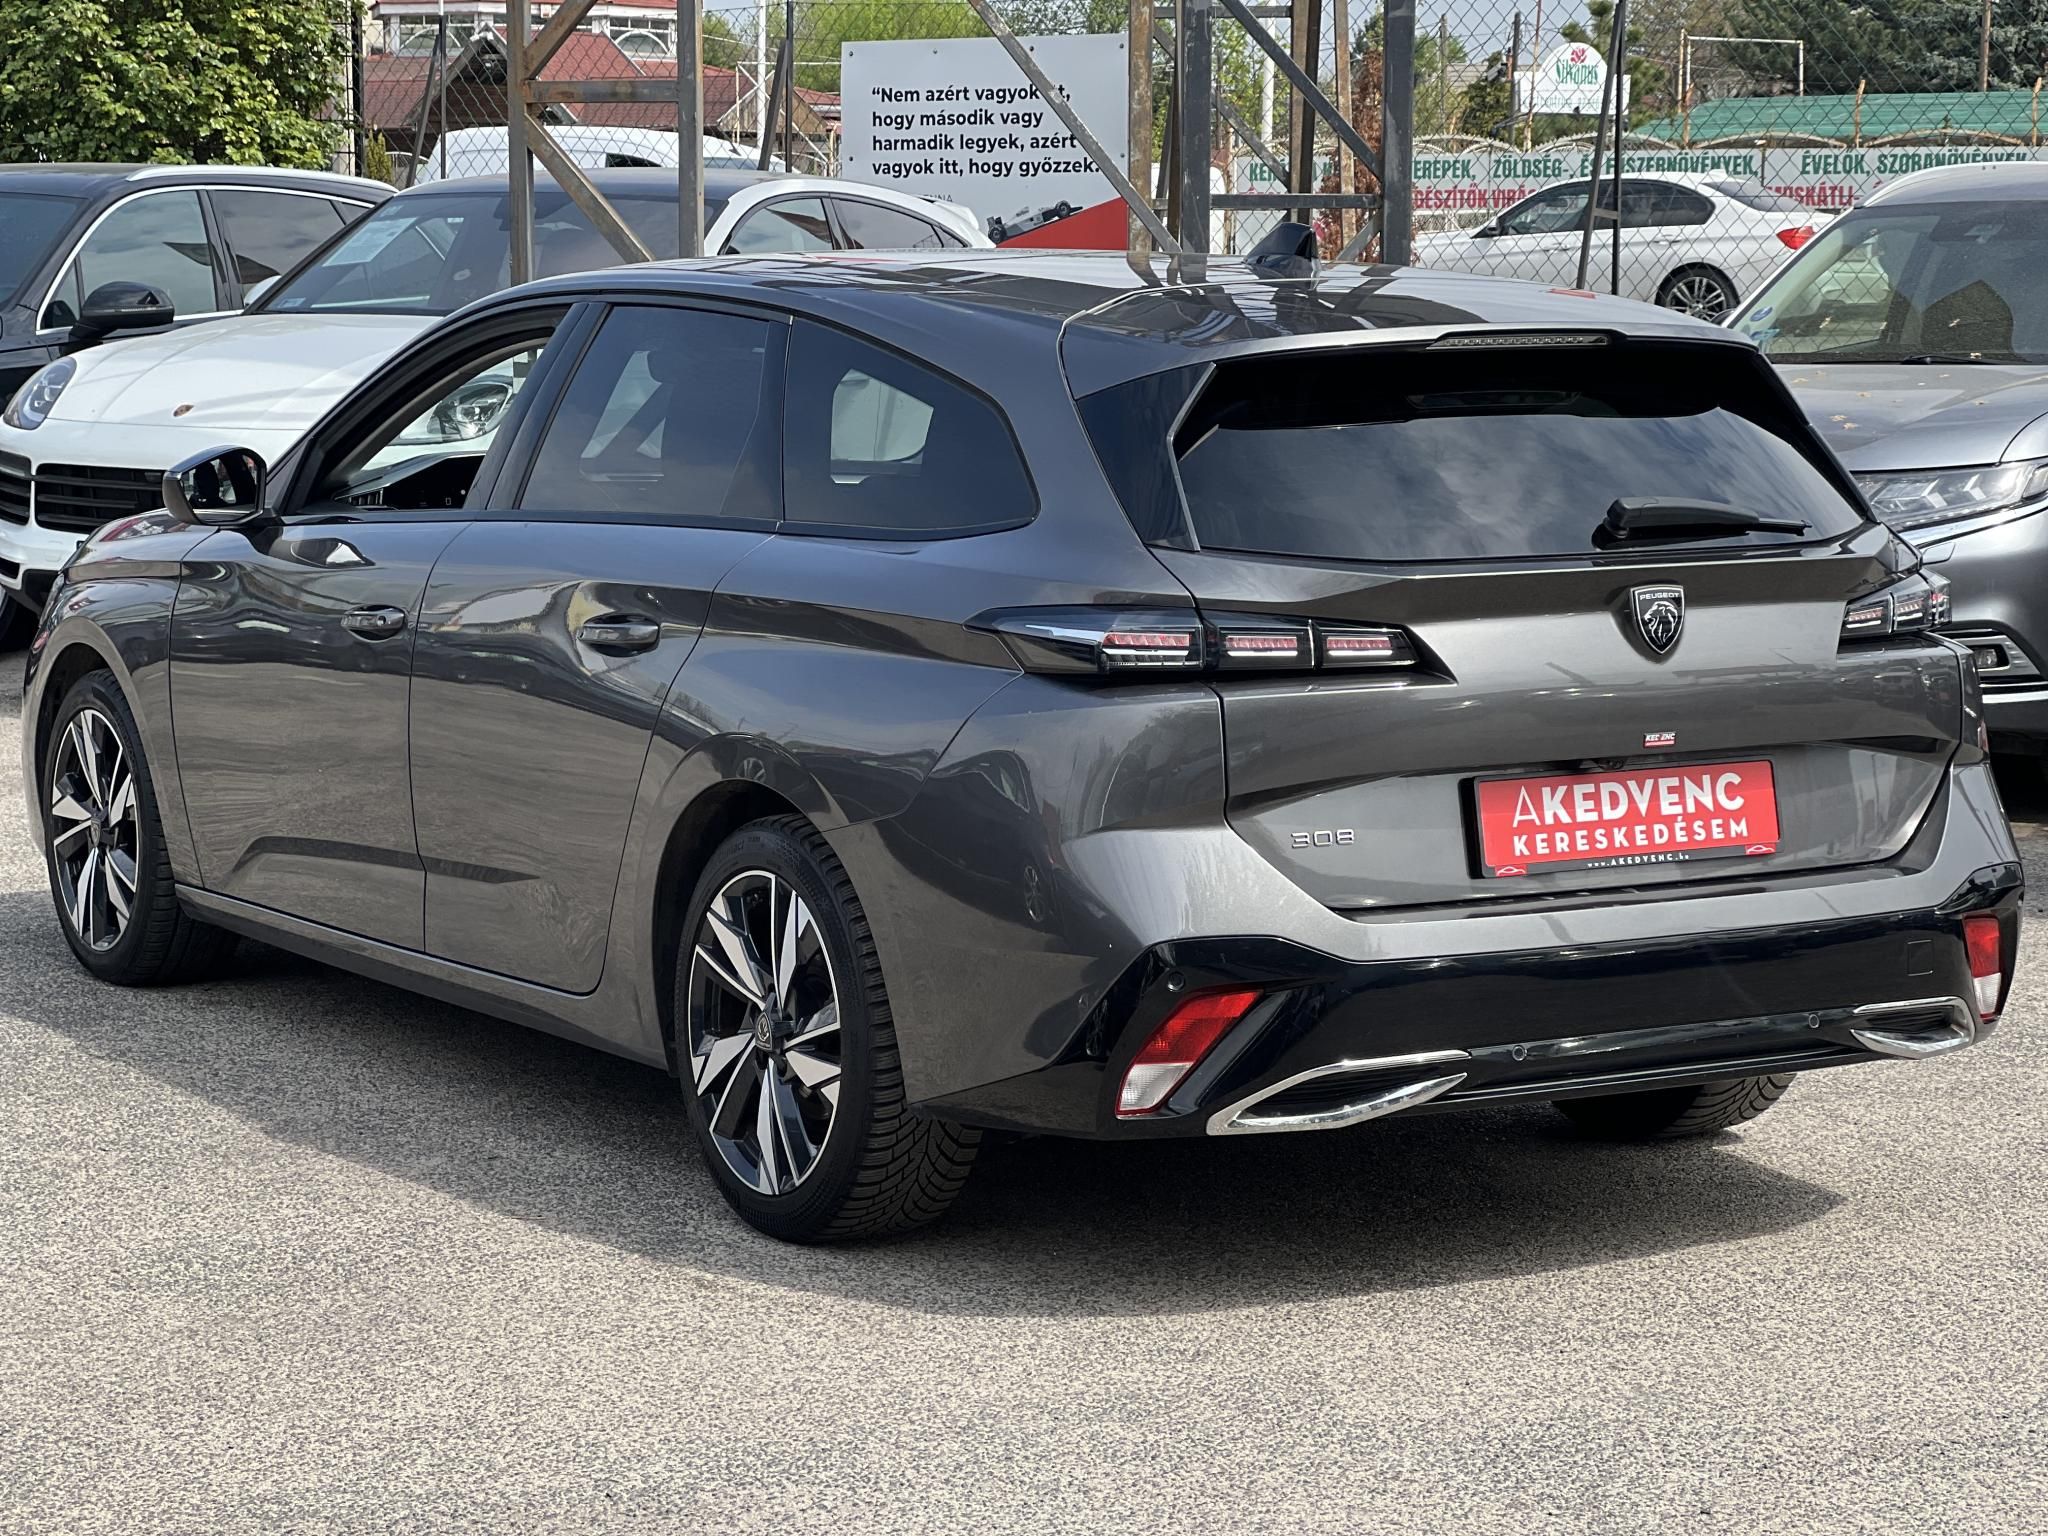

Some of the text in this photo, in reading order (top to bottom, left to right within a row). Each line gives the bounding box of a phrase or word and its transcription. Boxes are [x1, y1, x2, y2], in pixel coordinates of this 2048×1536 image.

[1556, 59, 1599, 85] Silvanus
[925, 85, 970, 102] azért
[975, 84, 1040, 105] vagyok
[872, 109, 1044, 130] hogy második vagy
[872, 132, 1077, 154] harmadik legyek, azért
[872, 159, 935, 178] vagyok
[939, 158, 964, 177] itt,
[968, 157, 1014, 177] hogy
[1413, 159, 1477, 181] EREPEK,
[1801, 148, 1871, 177] ÉVELŐK,
[1412, 182, 1488, 209] GÉSZÍTŐK
[1639, 592, 1681, 601] PEUGEOT
[1290, 828, 1355, 849] 308
[1513, 816, 1749, 857] KERESKEDÉSEM
